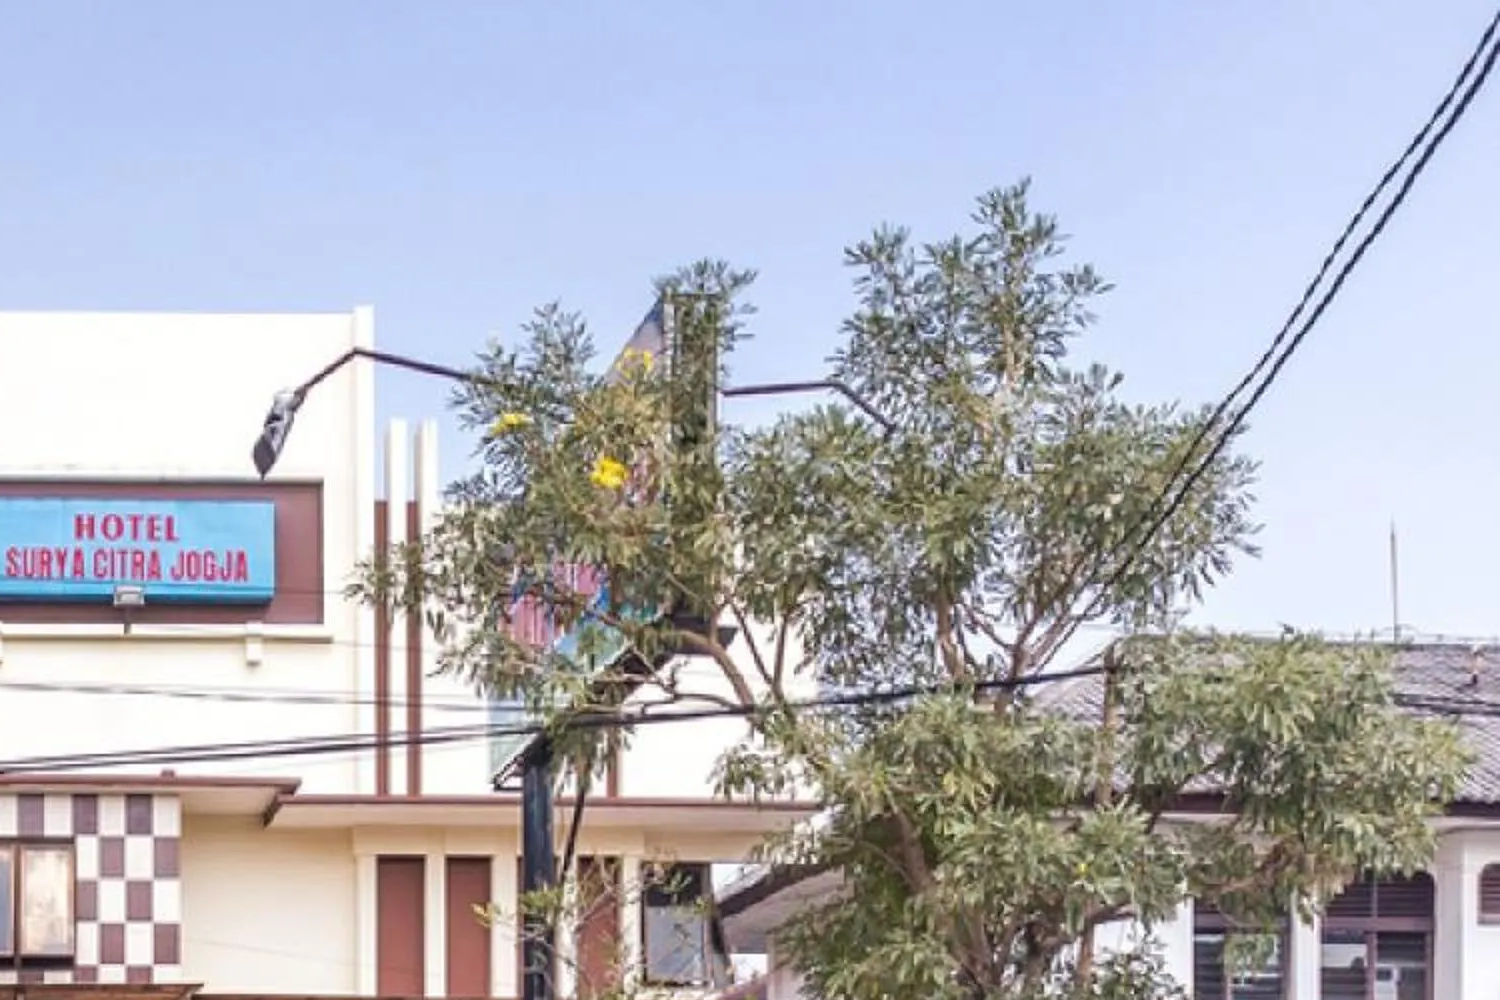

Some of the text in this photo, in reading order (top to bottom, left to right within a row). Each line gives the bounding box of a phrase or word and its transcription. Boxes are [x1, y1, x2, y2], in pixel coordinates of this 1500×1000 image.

[73, 513, 179, 542] HOTEL
[5, 546, 249, 582] SURYA CITRA JOGJA
